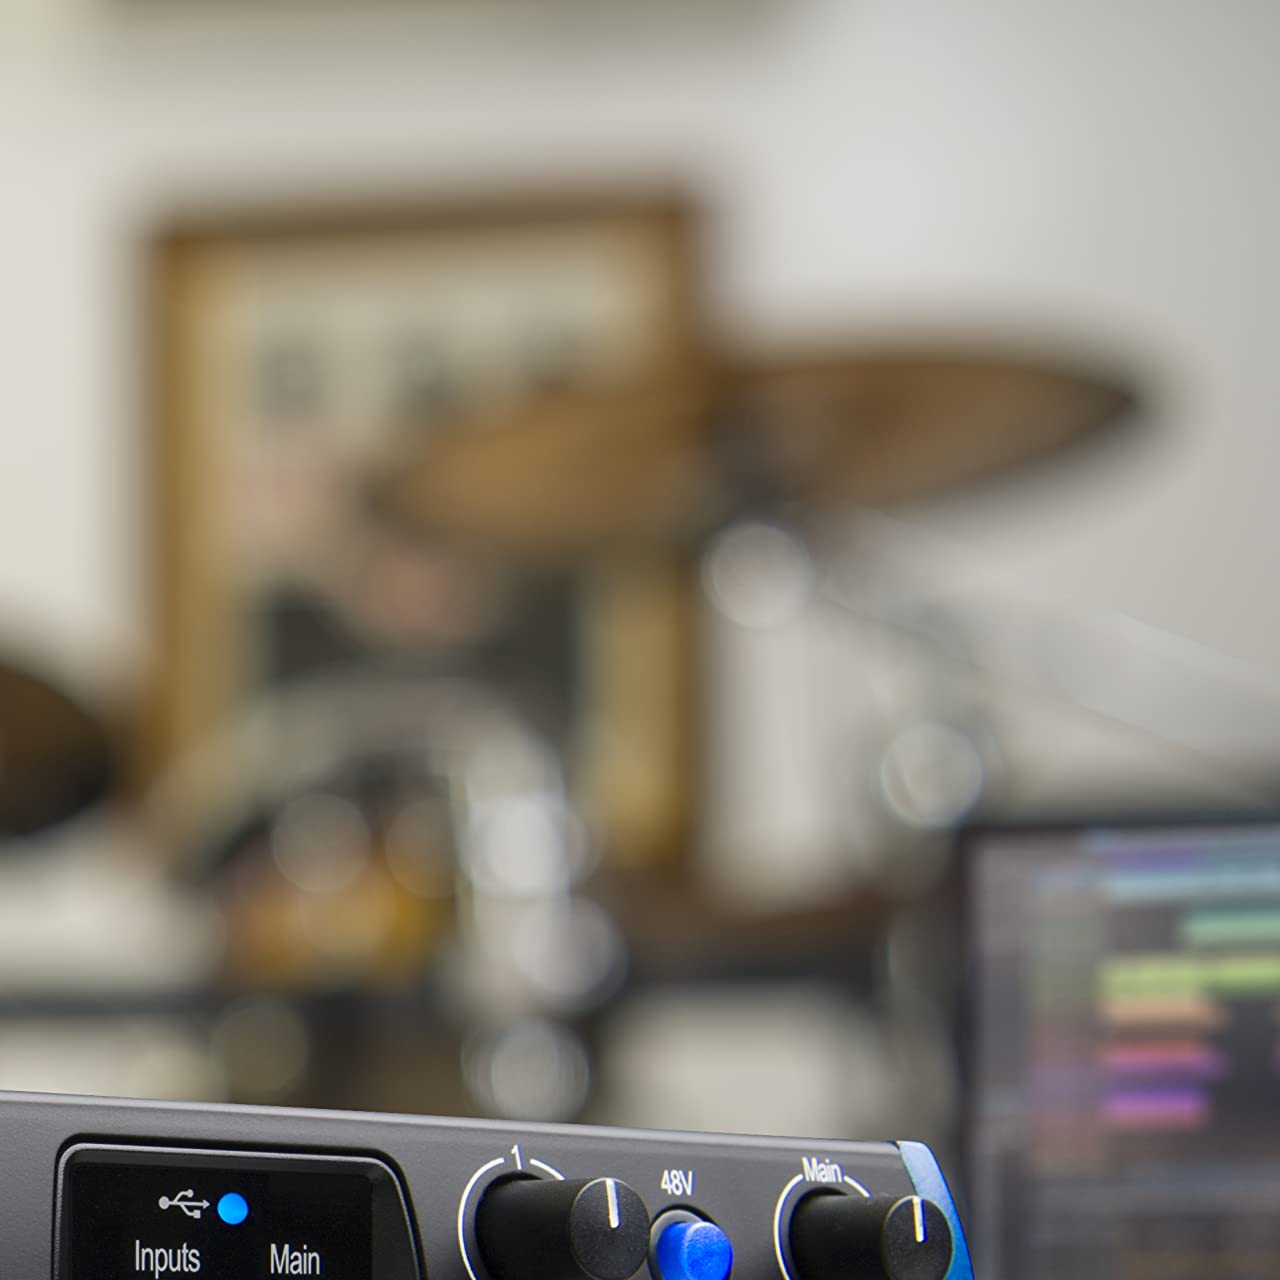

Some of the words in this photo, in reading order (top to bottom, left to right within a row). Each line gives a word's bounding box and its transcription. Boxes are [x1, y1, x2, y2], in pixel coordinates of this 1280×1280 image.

[510, 1143, 523, 1171] 1
[801, 1156, 844, 1184] Main
[660, 1169, 694, 1196] 48V
[135, 1239, 201, 1280] Inputs
[269, 1243, 321, 1276] Main
